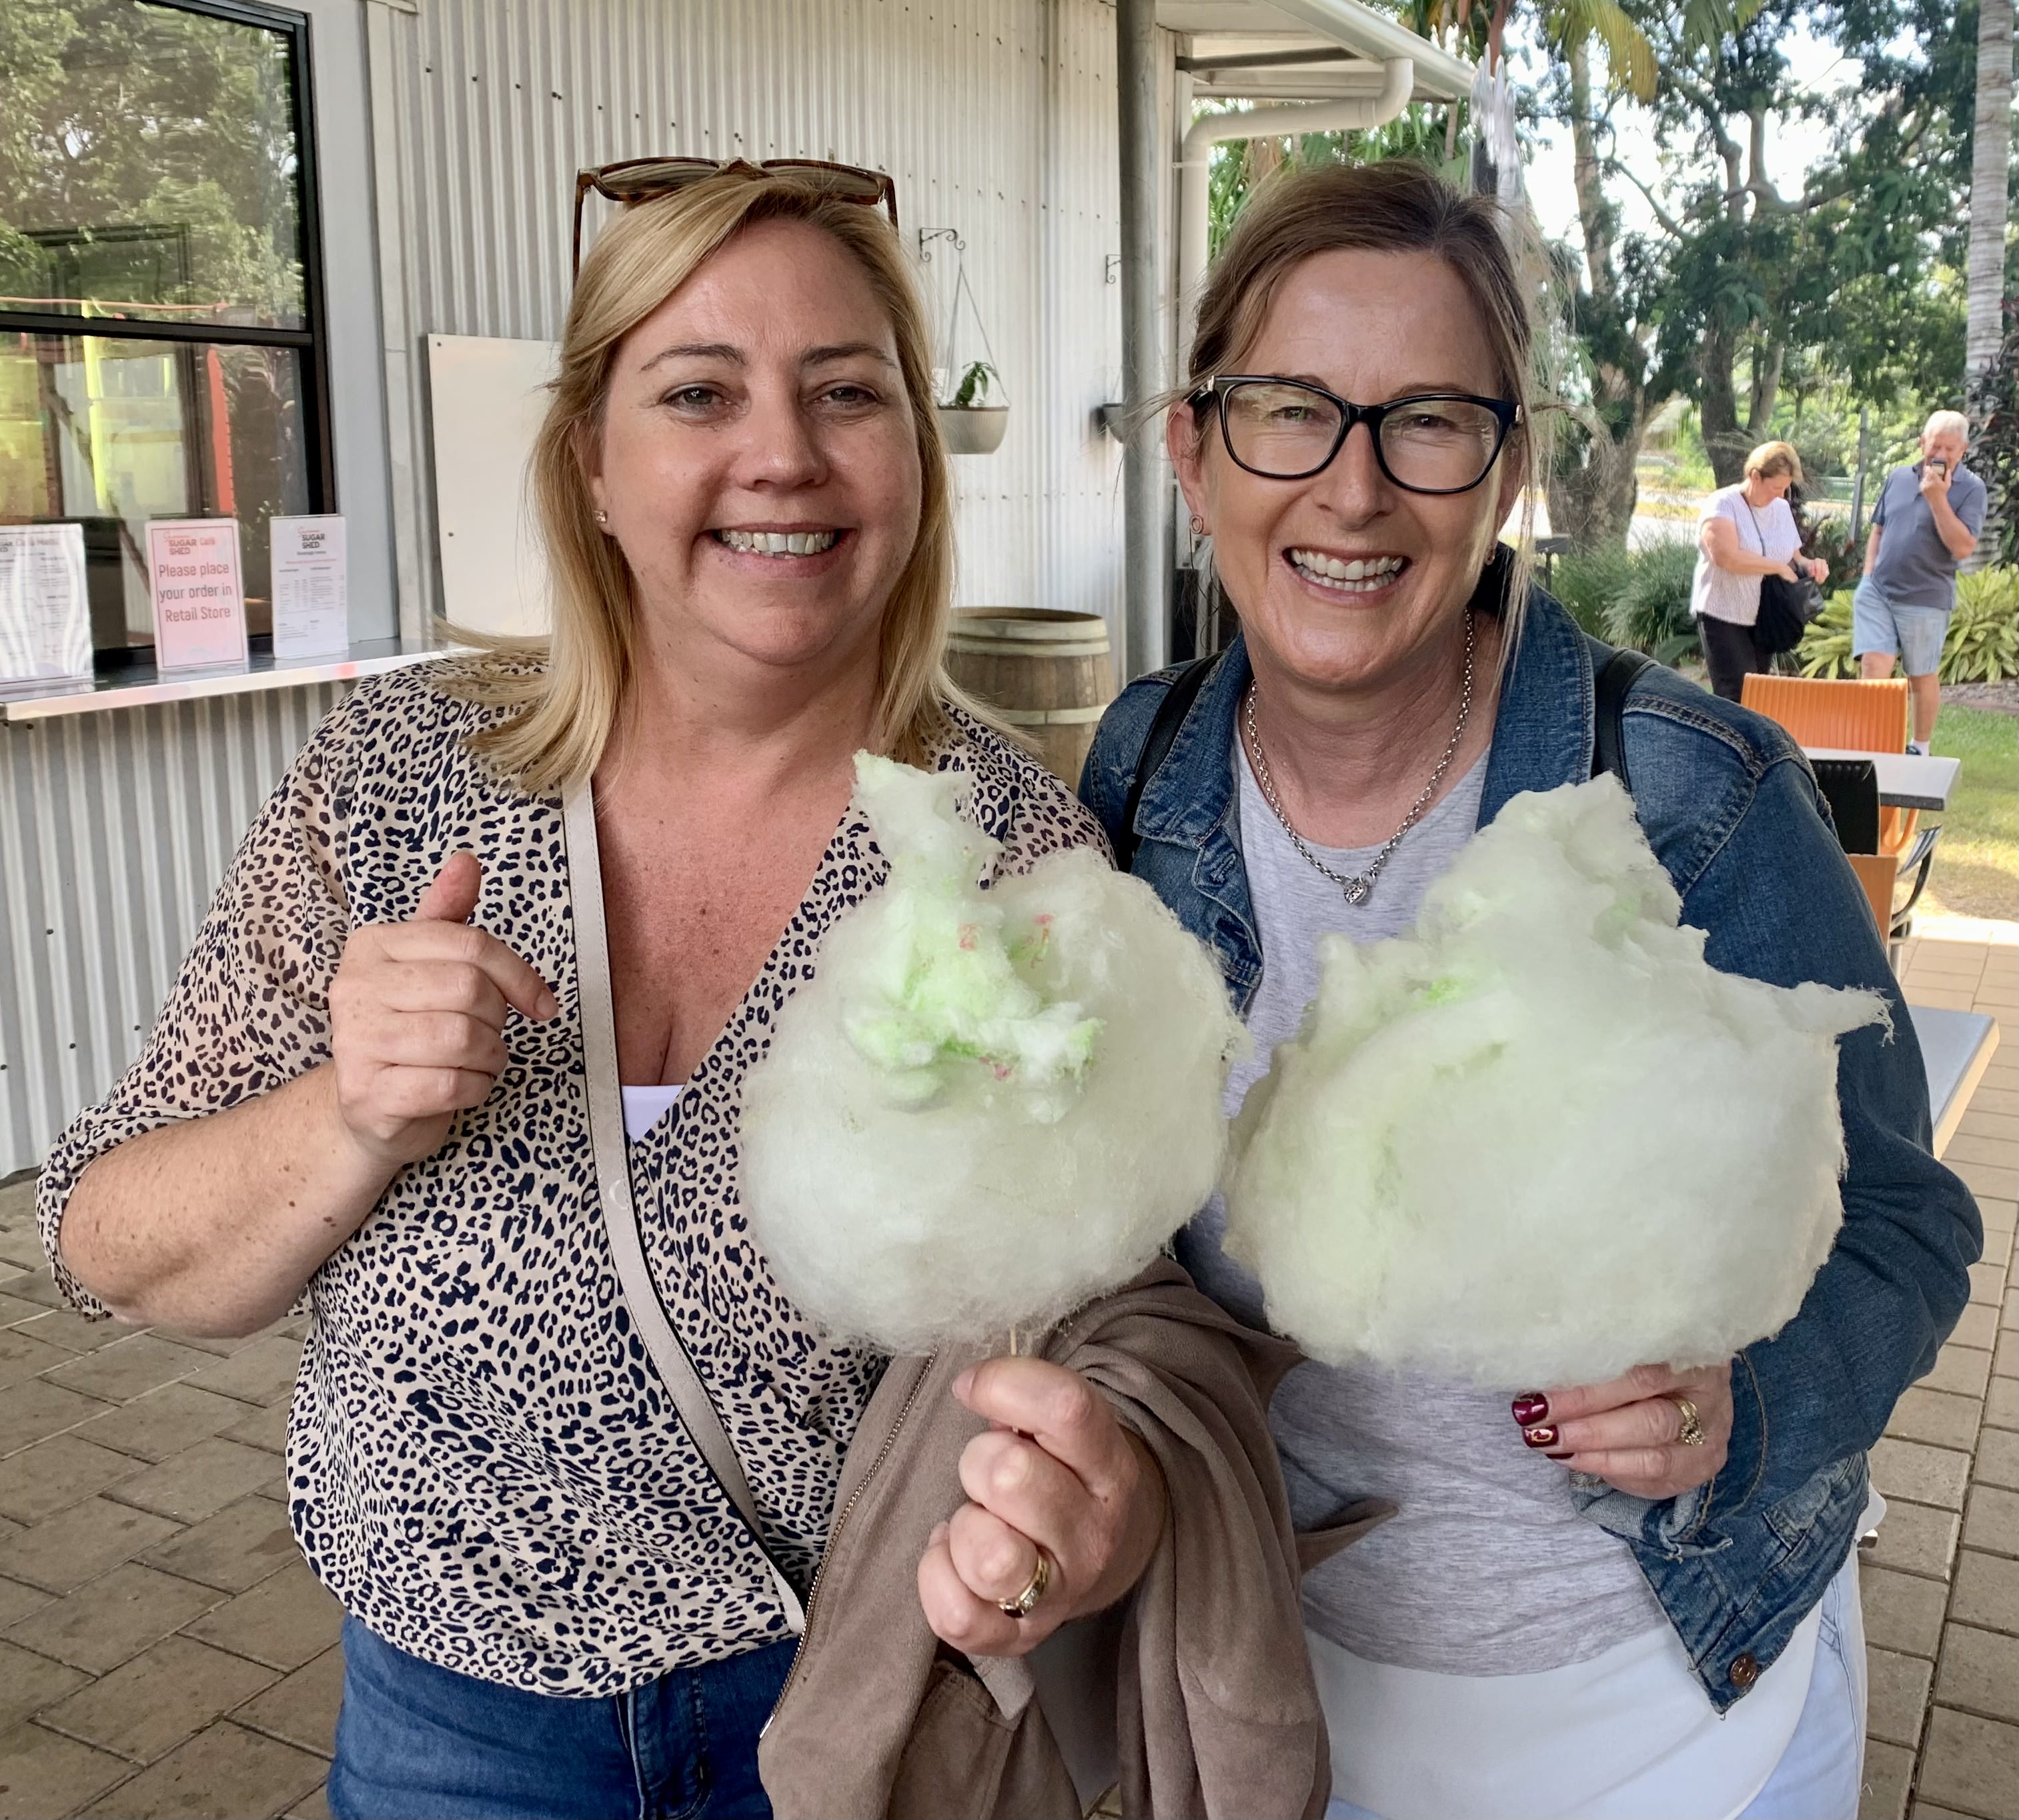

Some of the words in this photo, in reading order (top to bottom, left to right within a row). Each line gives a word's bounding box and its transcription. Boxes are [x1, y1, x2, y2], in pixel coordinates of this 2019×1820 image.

[169, 539, 197, 547] SUGAR
[169, 547, 191, 555] SHED
[159, 564, 196, 578] Please
[201, 562, 229, 578] place
[159, 588, 185, 603] your
[189, 585, 219, 598] order
[222, 583, 232, 596] in
[165, 608, 197, 622] Retail
[201, 606, 230, 620] Store
